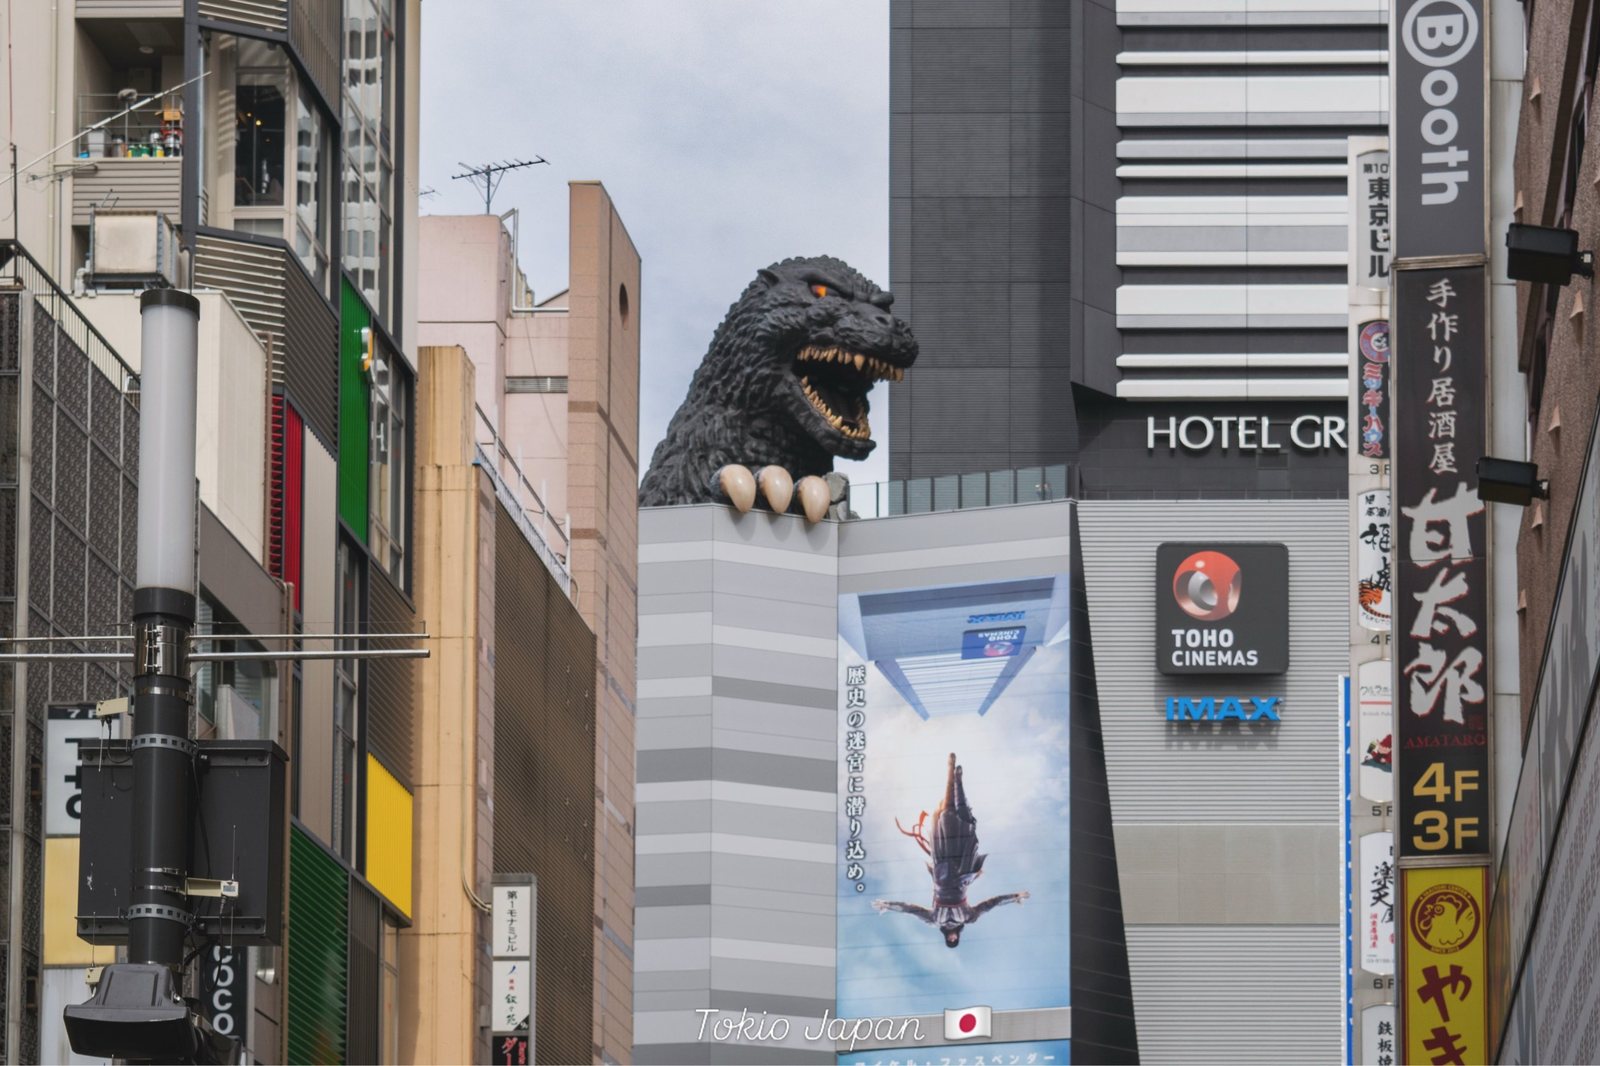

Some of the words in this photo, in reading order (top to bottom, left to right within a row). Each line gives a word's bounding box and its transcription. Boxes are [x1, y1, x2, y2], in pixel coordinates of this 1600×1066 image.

[1402, 0, 1479, 206] Booth
[1368, 177, 1390, 278] 東京ビル
[1426, 278, 1458, 475] 手作り居酒屋
[1147, 416, 1281, 449] HOTEL
[1290, 415, 1348, 449] GR
[1401, 482, 1485, 724] 甘太郎
[1171, 628, 1234, 648] TOHO
[1171, 650, 1259, 667] CINEMAS
[1165, 696, 1281, 721] IMAX
[1404, 733, 1486, 749] AMATARO
[846, 665, 866, 893] 歴史の迷宮に潜り込め。
[1413, 762, 1479, 802] 4F
[1413, 810, 1479, 851] 3F
[506, 890, 518, 952] 第1モナミビル
[1417, 964, 1472, 1065] やき
